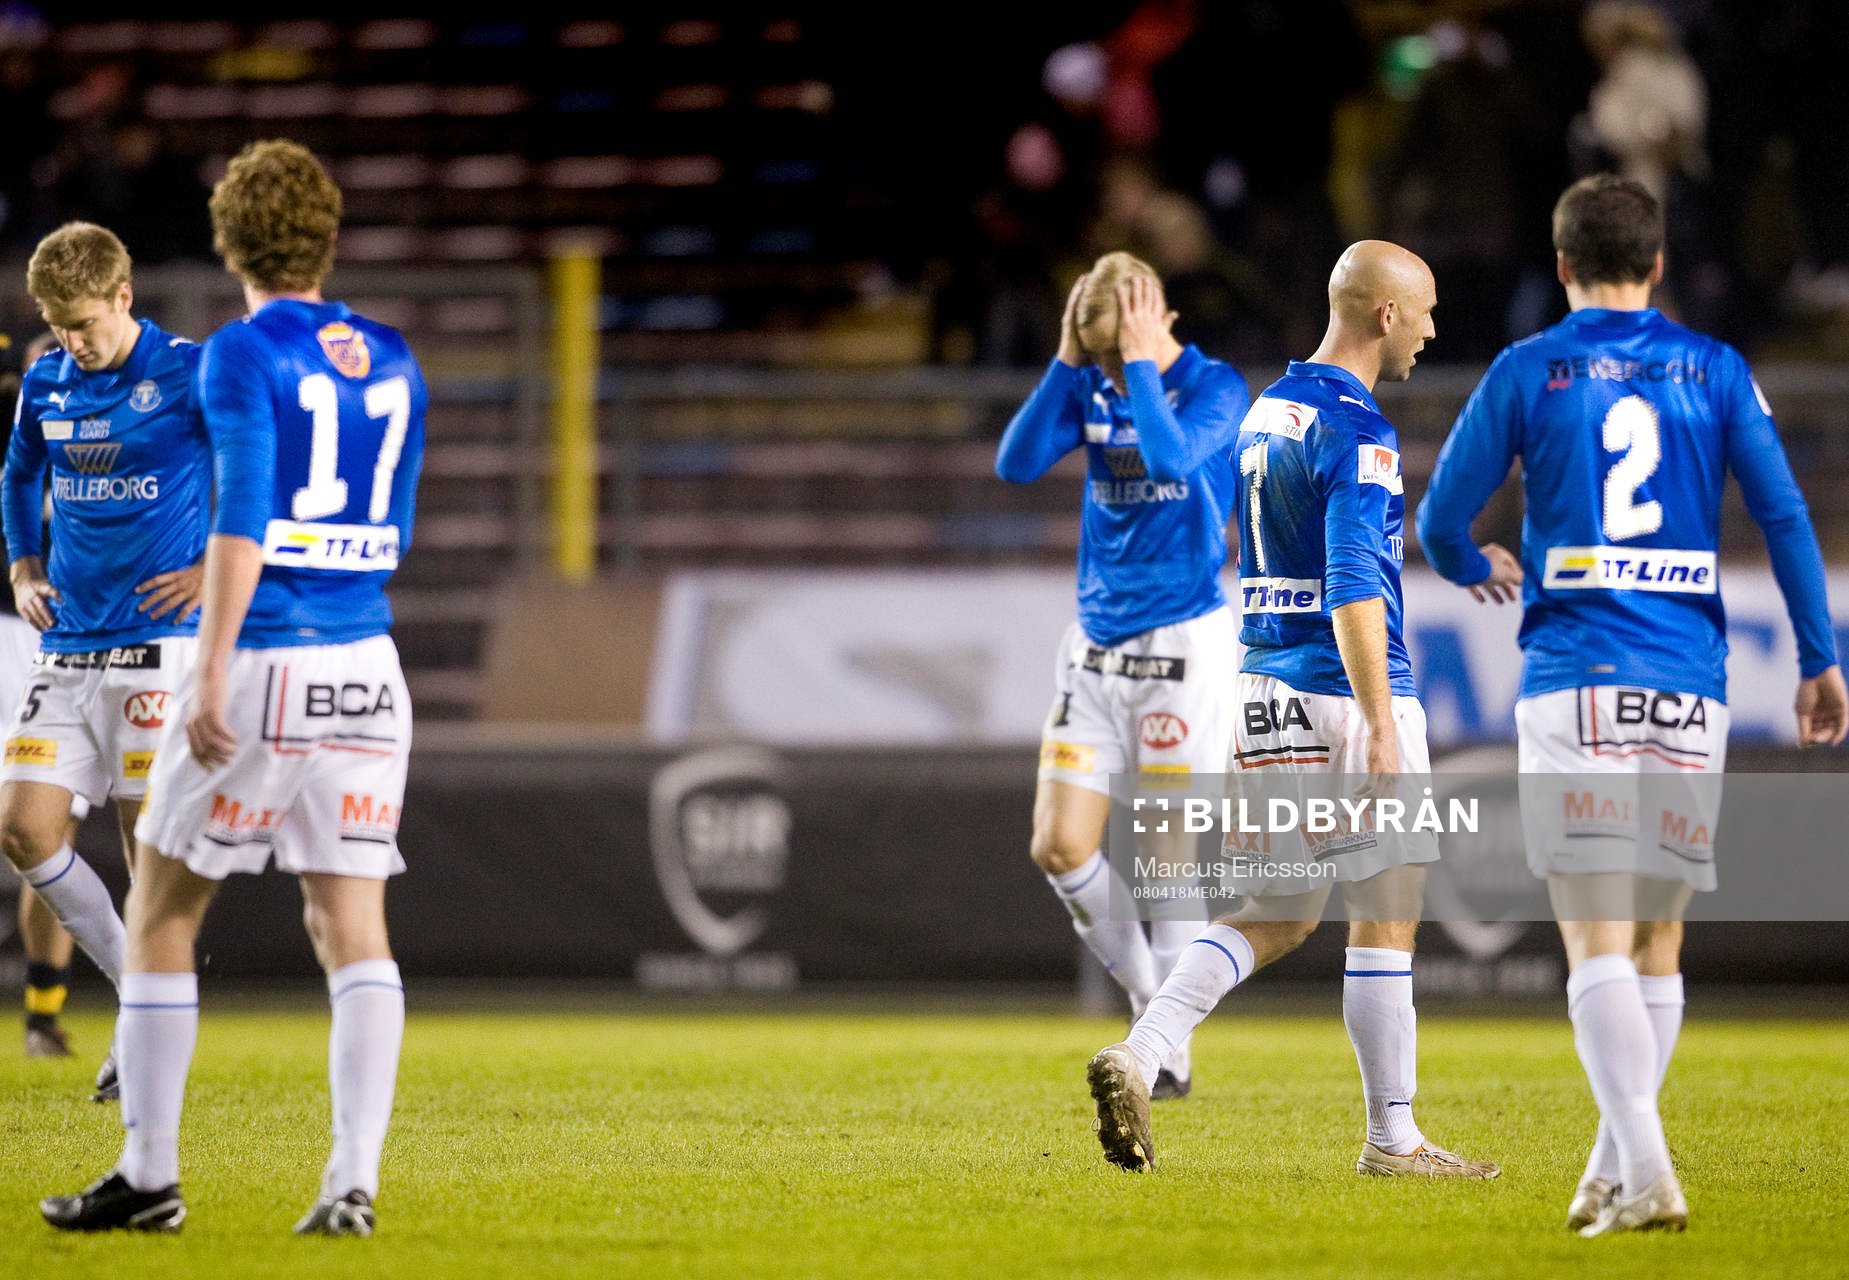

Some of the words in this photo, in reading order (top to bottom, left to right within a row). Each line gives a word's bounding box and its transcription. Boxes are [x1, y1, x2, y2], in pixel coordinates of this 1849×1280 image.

[293, 373, 411, 522] 17
[1603, 394, 1663, 542] 2
[1603, 559, 1709, 584] TT-Line
[20, 685, 49, 723] 5
[305, 683, 394, 717] BCA
[1616, 690, 1707, 732] BCA
